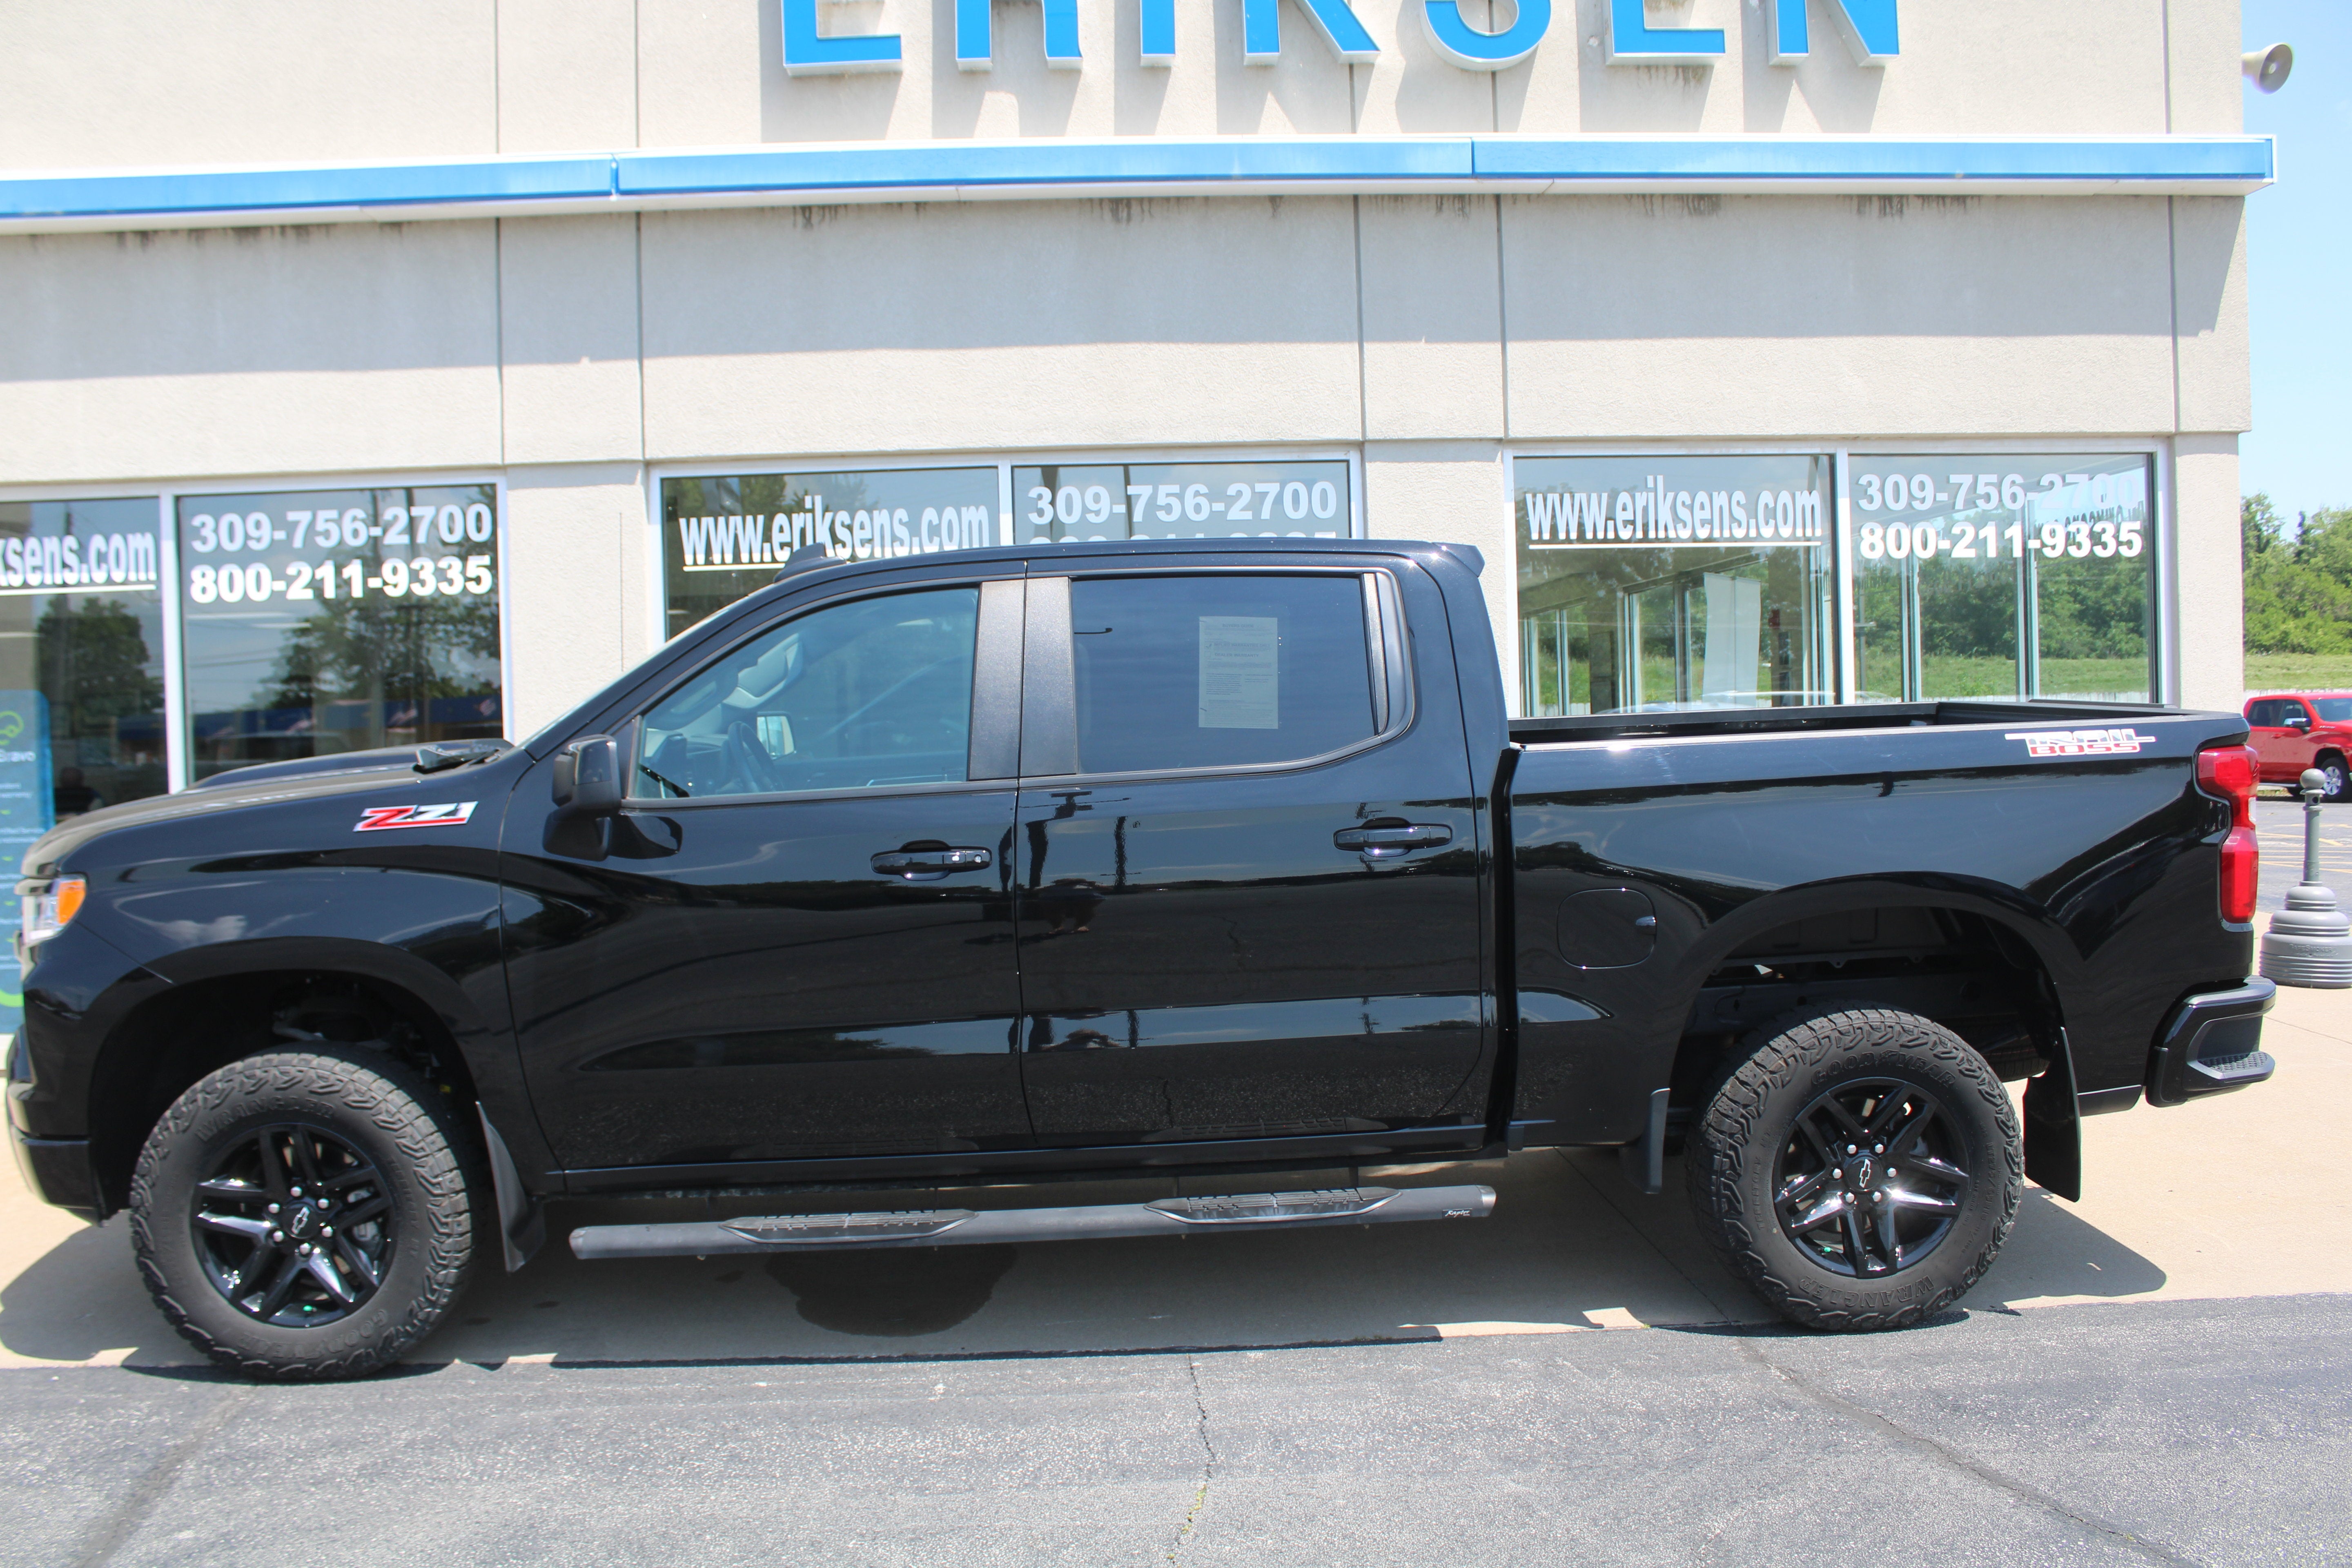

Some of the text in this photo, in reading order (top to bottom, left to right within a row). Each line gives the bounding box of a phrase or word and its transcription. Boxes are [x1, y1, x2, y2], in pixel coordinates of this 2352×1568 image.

[1028, 481, 1336, 525] 309-756-2700
[1526, 475, 1821, 540] www.eriksens.com
[1858, 474, 2140, 511] 309-756-2700
[191, 503, 492, 552] 309-756-2700
[679, 495, 989, 565] www.eriksens.com
[1860, 520, 2142, 559] 800-211-9335
[190, 555, 493, 604] 800-211-9335
[2005, 728, 2156, 745] TRAIL
[2029, 743, 2140, 757] BOSS
[353, 801, 479, 832] Z71
[1811, 1049, 1956, 1088] GOODYEAR
[195, 1096, 334, 1142] WRANGLER
[1445, 1209, 1470, 1218] Raptor
[1798, 1275, 1934, 1308] WRANGLER
